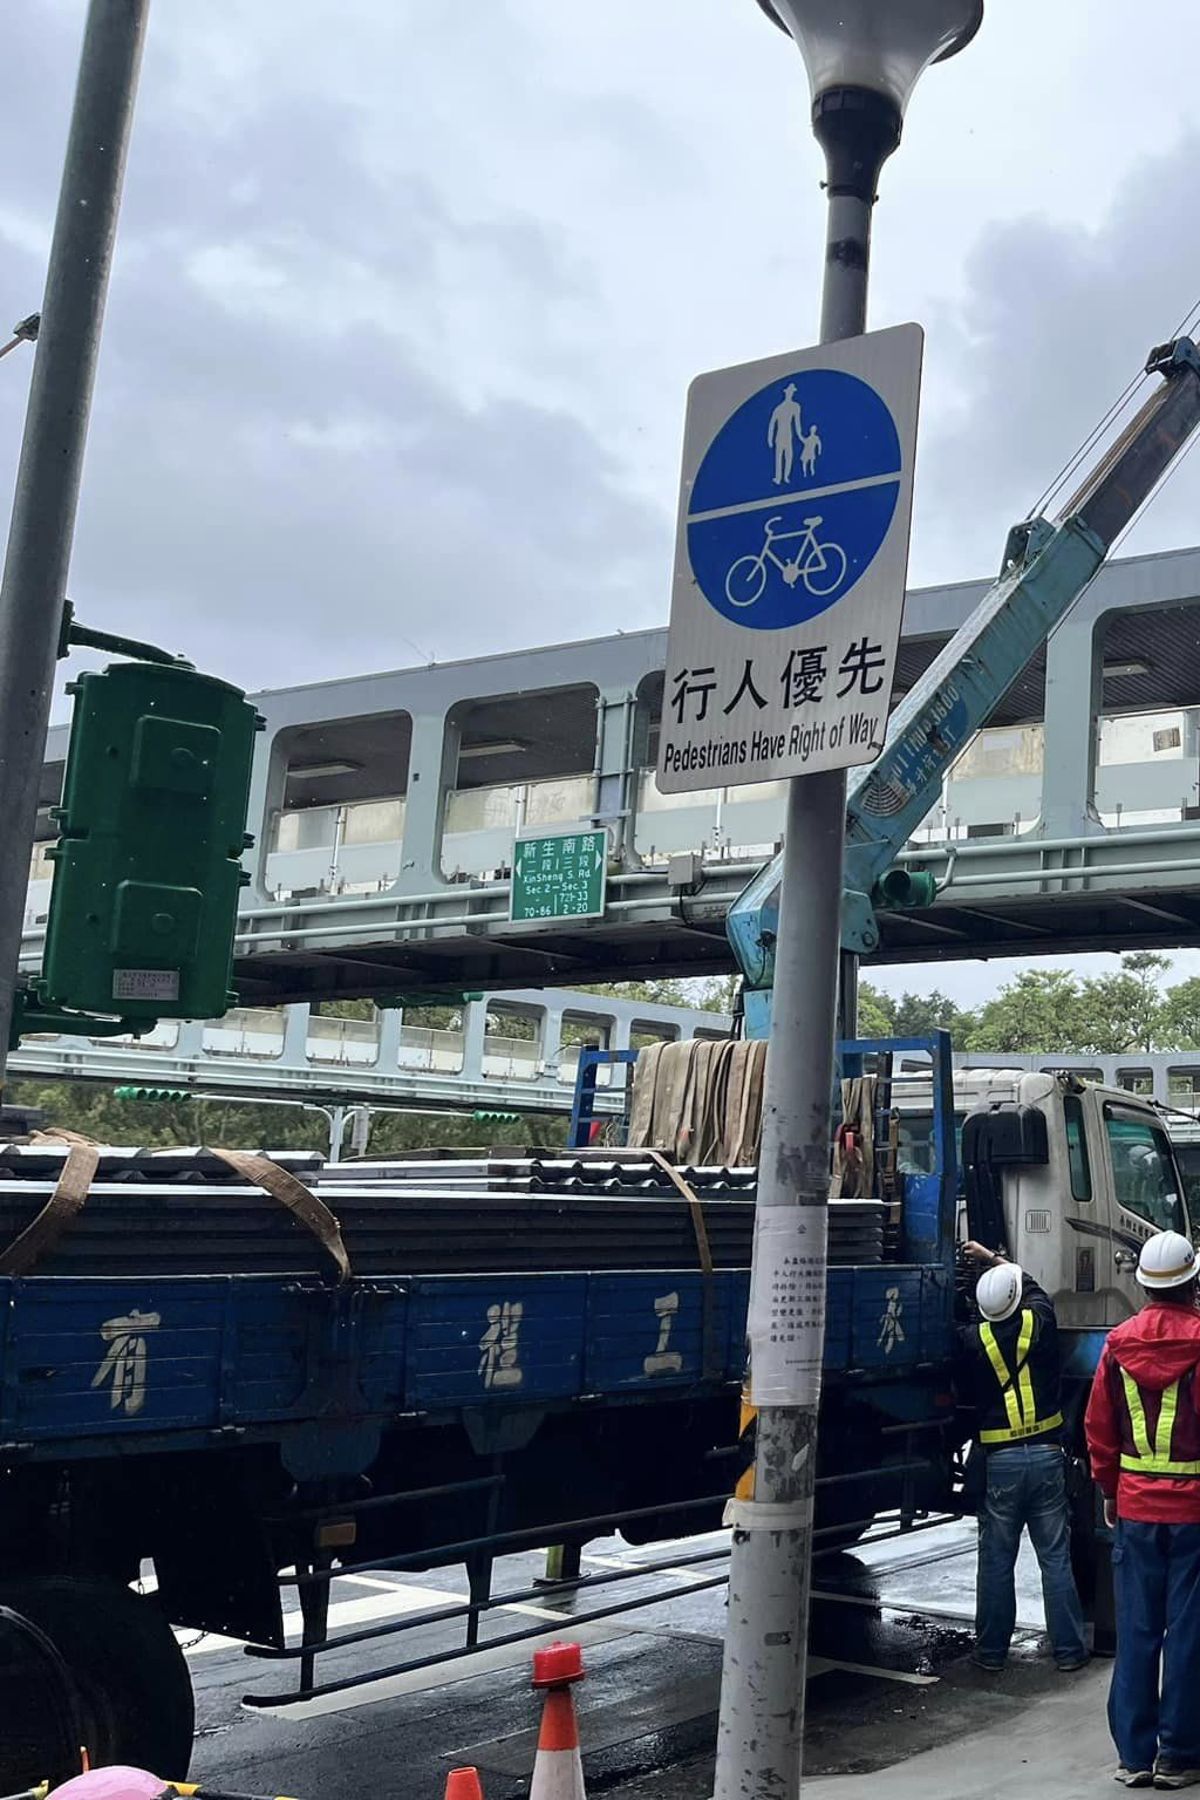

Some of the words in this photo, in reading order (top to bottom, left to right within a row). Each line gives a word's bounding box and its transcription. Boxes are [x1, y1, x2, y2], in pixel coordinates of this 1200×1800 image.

[671, 637, 886, 723] 行人優先
[664, 737, 747, 773] Pedestrians
[750, 730, 785, 762] Have
[789, 721, 826, 762] Right
[829, 716, 846, 748] of
[849, 712, 879, 749] Way
[523, 835, 595, 858] 新生南路
[526, 859, 552, 872] 二段
[562, 855, 590, 870] 三段
[525, 885, 542, 895] Sec
[544, 884, 551, 893] 2
[561, 882, 579, 891] Sec
